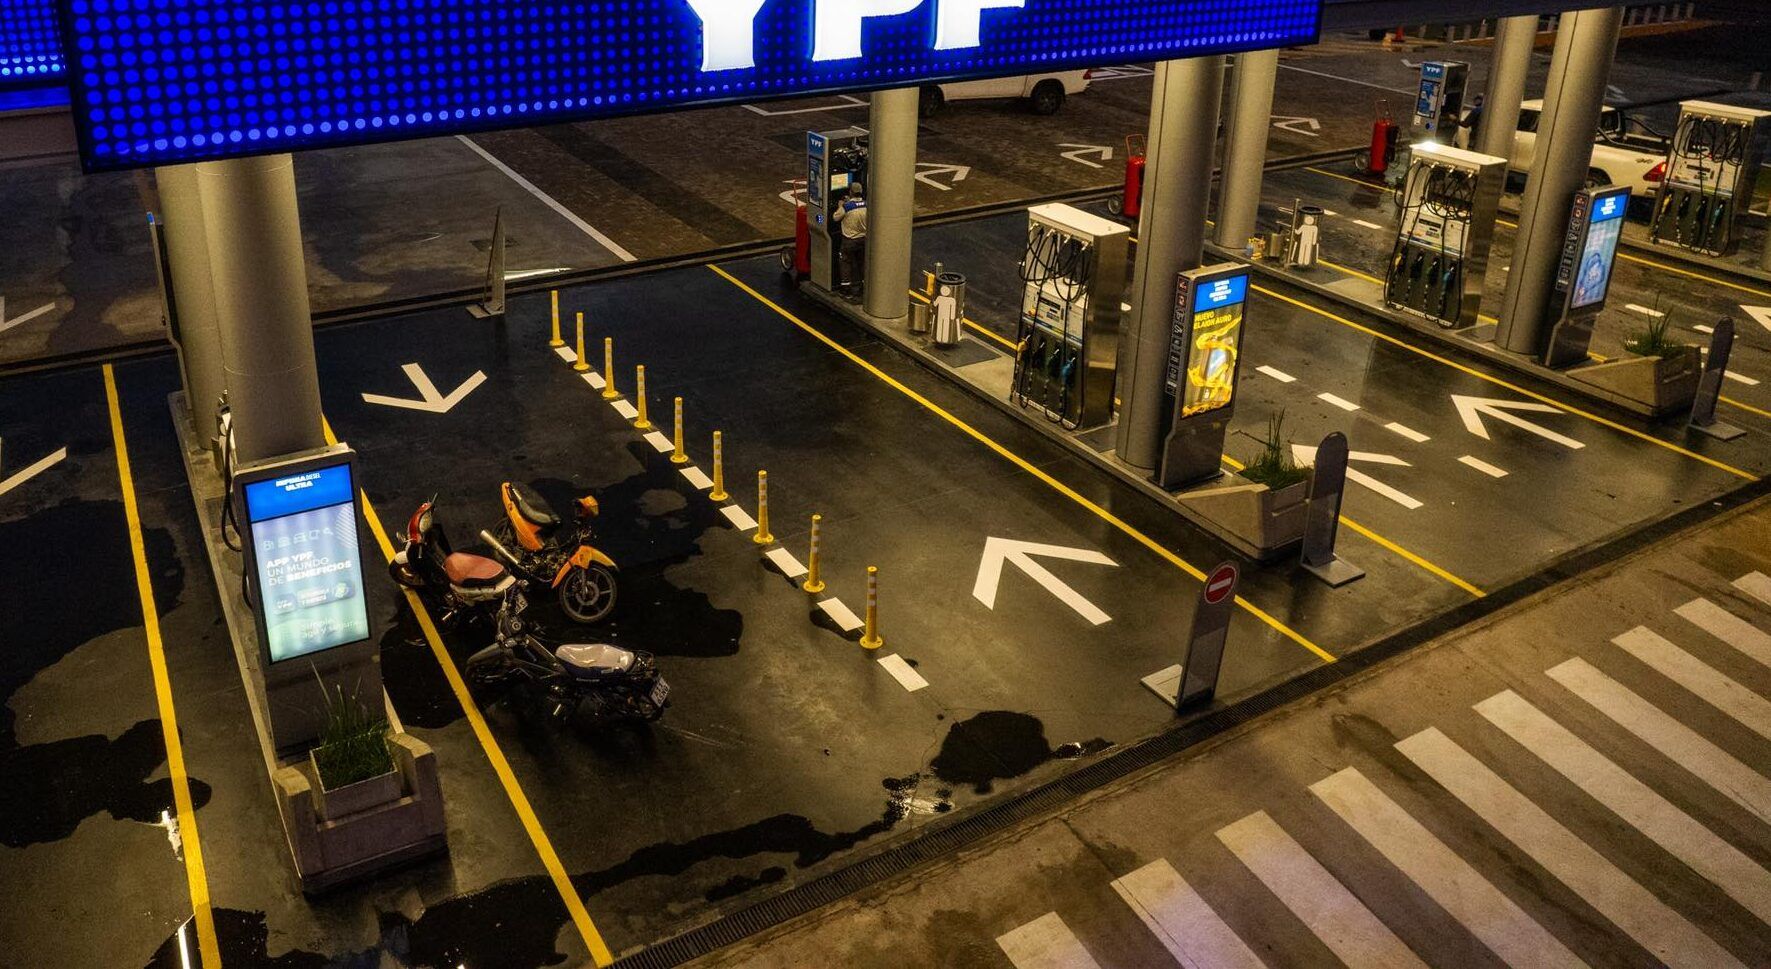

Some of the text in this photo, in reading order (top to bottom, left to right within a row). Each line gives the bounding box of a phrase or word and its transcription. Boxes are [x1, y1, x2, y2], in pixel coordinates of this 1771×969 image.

[811, 138, 822, 147] YPF
[1195, 311, 1215, 321] NUEVO
[266, 551, 314, 568] APP YPF
[267, 557, 329, 577] UN MUNDO
[268, 560, 352, 586] DE BENEFICIOS
